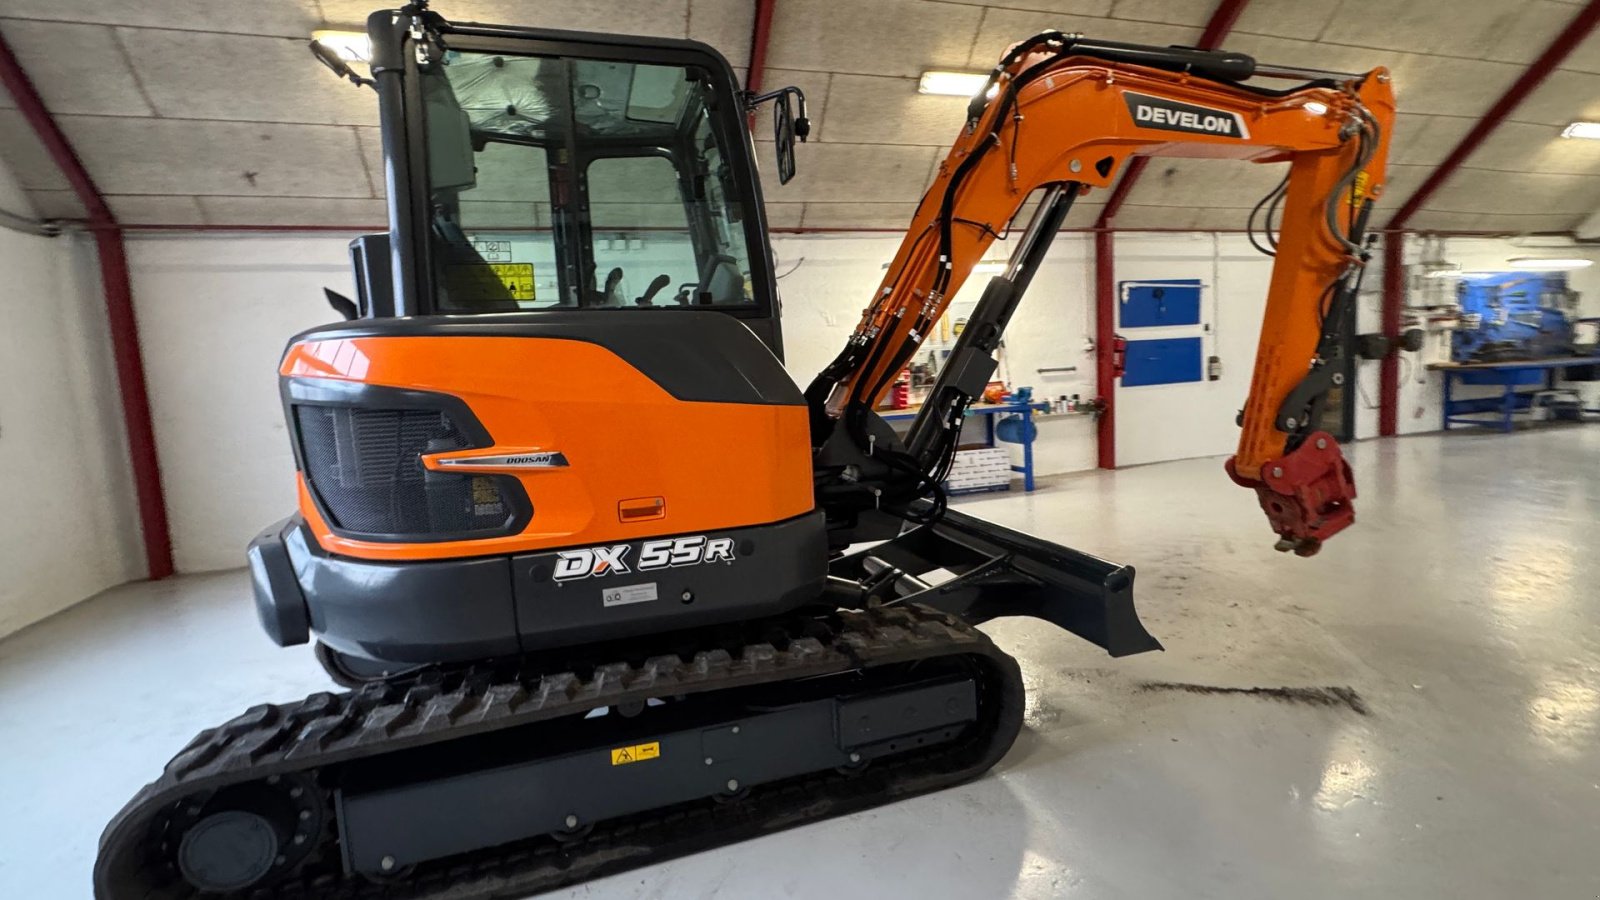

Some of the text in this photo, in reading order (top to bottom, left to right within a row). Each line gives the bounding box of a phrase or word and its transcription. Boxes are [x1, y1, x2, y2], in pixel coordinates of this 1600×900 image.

[1136, 104, 1232, 133] DEVELON
[506, 455, 550, 464] DOOSAN
[553, 544, 631, 582] DX
